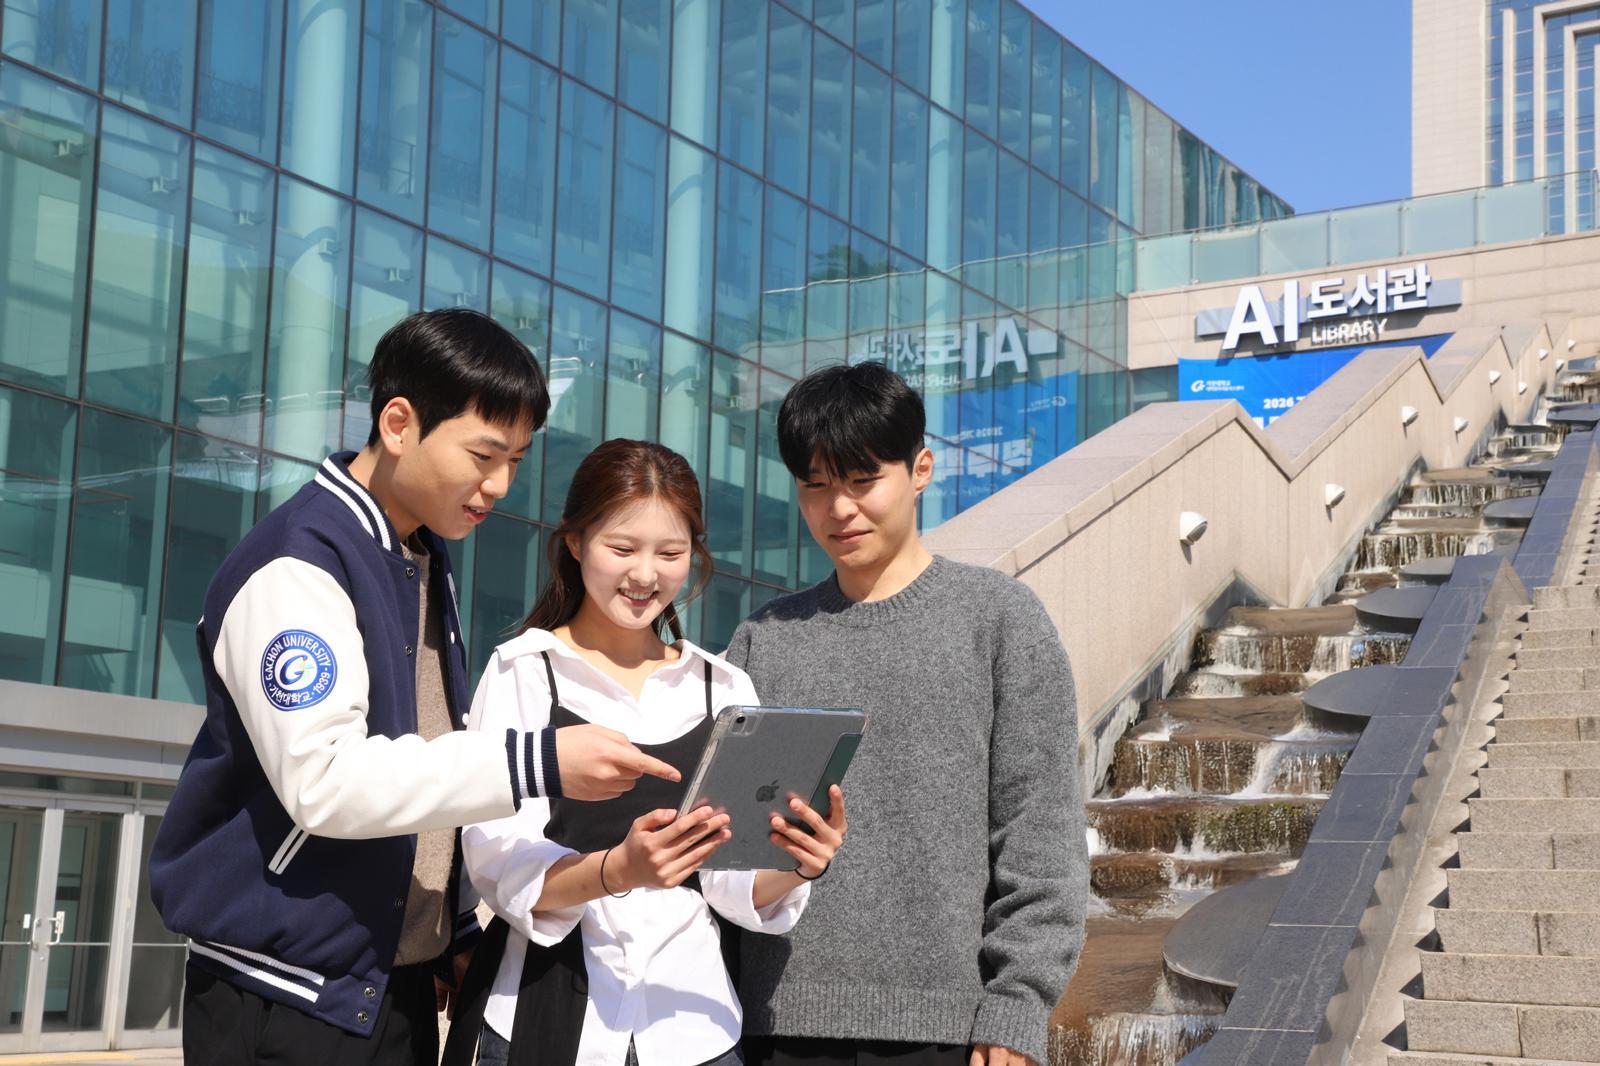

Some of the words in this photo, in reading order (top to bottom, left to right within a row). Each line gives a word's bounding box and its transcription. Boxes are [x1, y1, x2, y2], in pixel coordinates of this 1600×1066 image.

[1222, 280, 1299, 350] AI
[1307, 264, 1431, 319] 도서관
[1311, 319, 1387, 343] LIBRARY
[1263, 396, 1294, 409] 2026
[264, 641, 284, 681] GACHON
[282, 634, 332, 666] UNIVERSITY
[313, 672, 330, 694] 1939
[269, 684, 313, 705] 가천대학교
